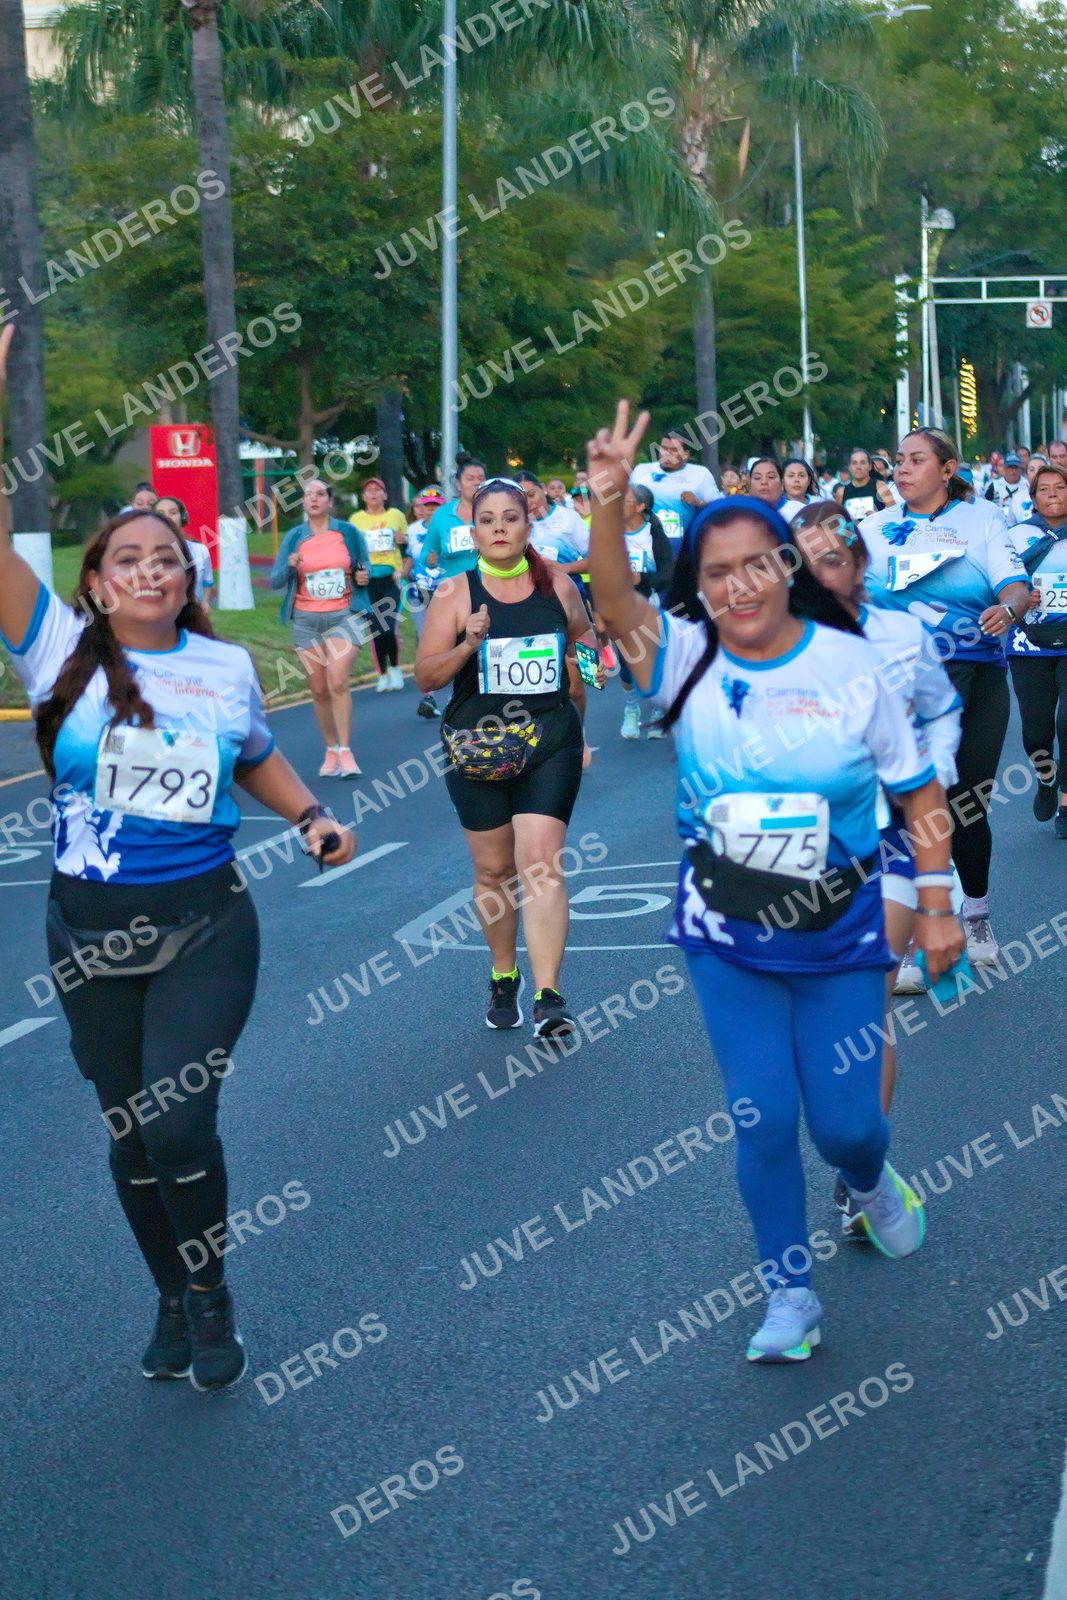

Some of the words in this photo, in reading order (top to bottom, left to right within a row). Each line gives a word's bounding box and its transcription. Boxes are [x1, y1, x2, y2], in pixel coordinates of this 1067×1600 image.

[157, 457, 213, 468] HONDA
[311, 581, 345, 596] 1876
[1046, 590, 1067, 608] 25
[493, 658, 557, 686] 1005
[107, 764, 212, 808] 1793
[568, 882, 679, 920] 5
